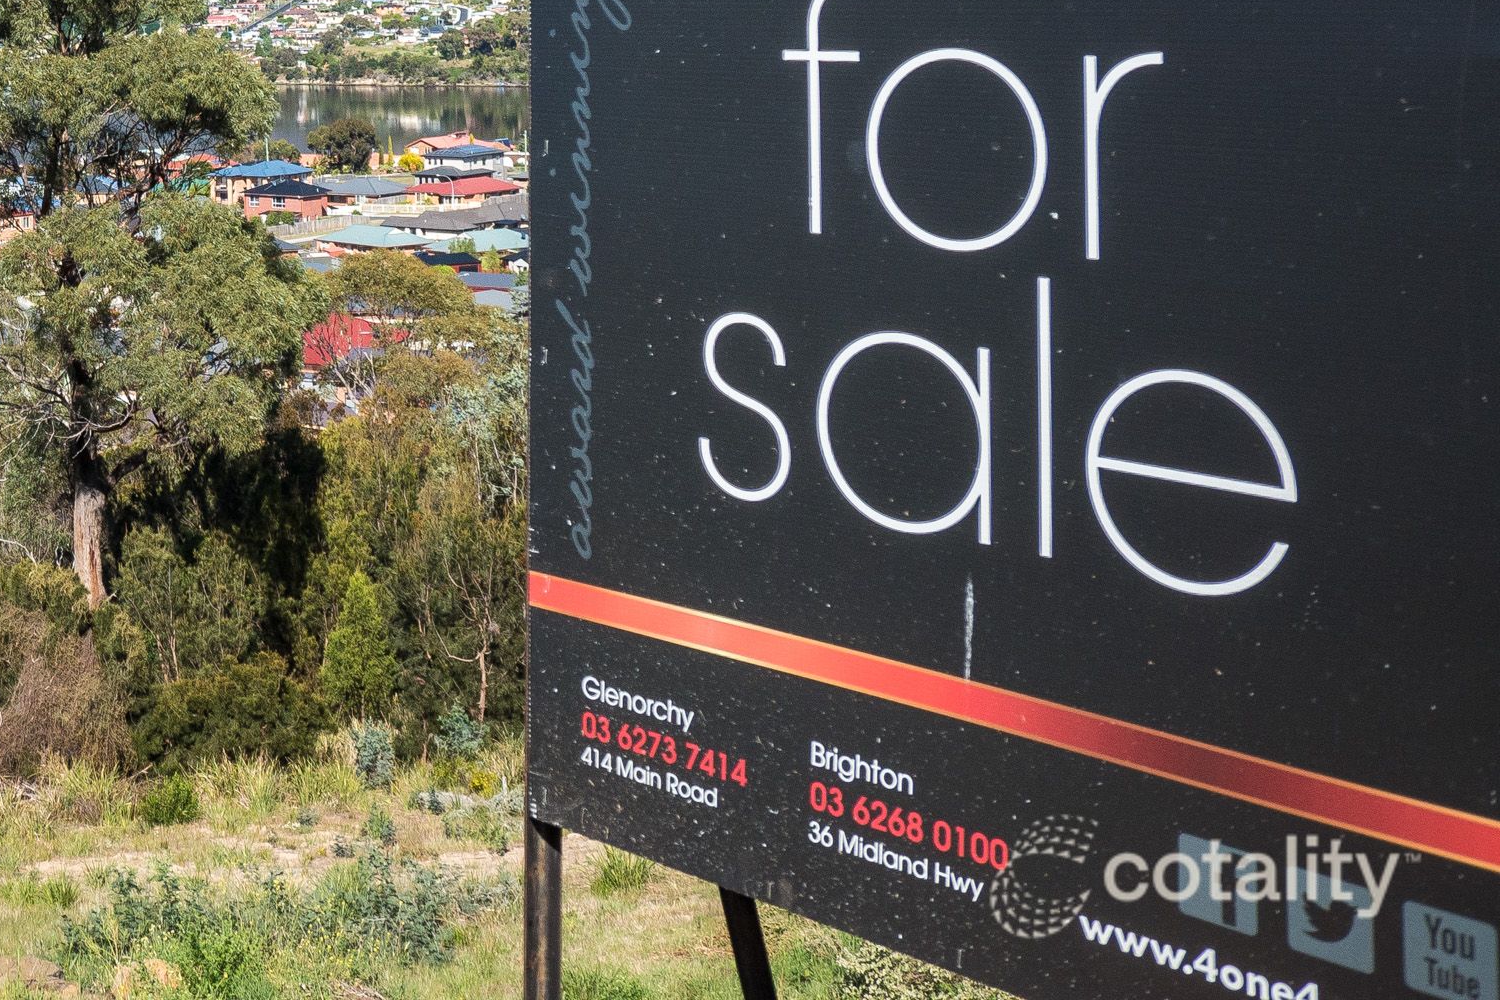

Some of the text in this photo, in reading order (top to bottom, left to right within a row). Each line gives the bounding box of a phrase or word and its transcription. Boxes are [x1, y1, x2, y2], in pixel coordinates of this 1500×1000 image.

[556, 299, 595, 560] award
[699, 277, 1298, 596] sale
[581, 675, 694, 732] Glenorchy
[581, 711, 748, 787] 03 6273 7414
[581, 746, 718, 808] 414 Main Road
[810, 740, 914, 795] Brighton
[809, 781, 1010, 870] 03 6268 0100
[808, 820, 985, 902] 36 Midland Hwy
[1422, 913, 1476, 960] You
[1422, 957, 1481, 999] Tube
